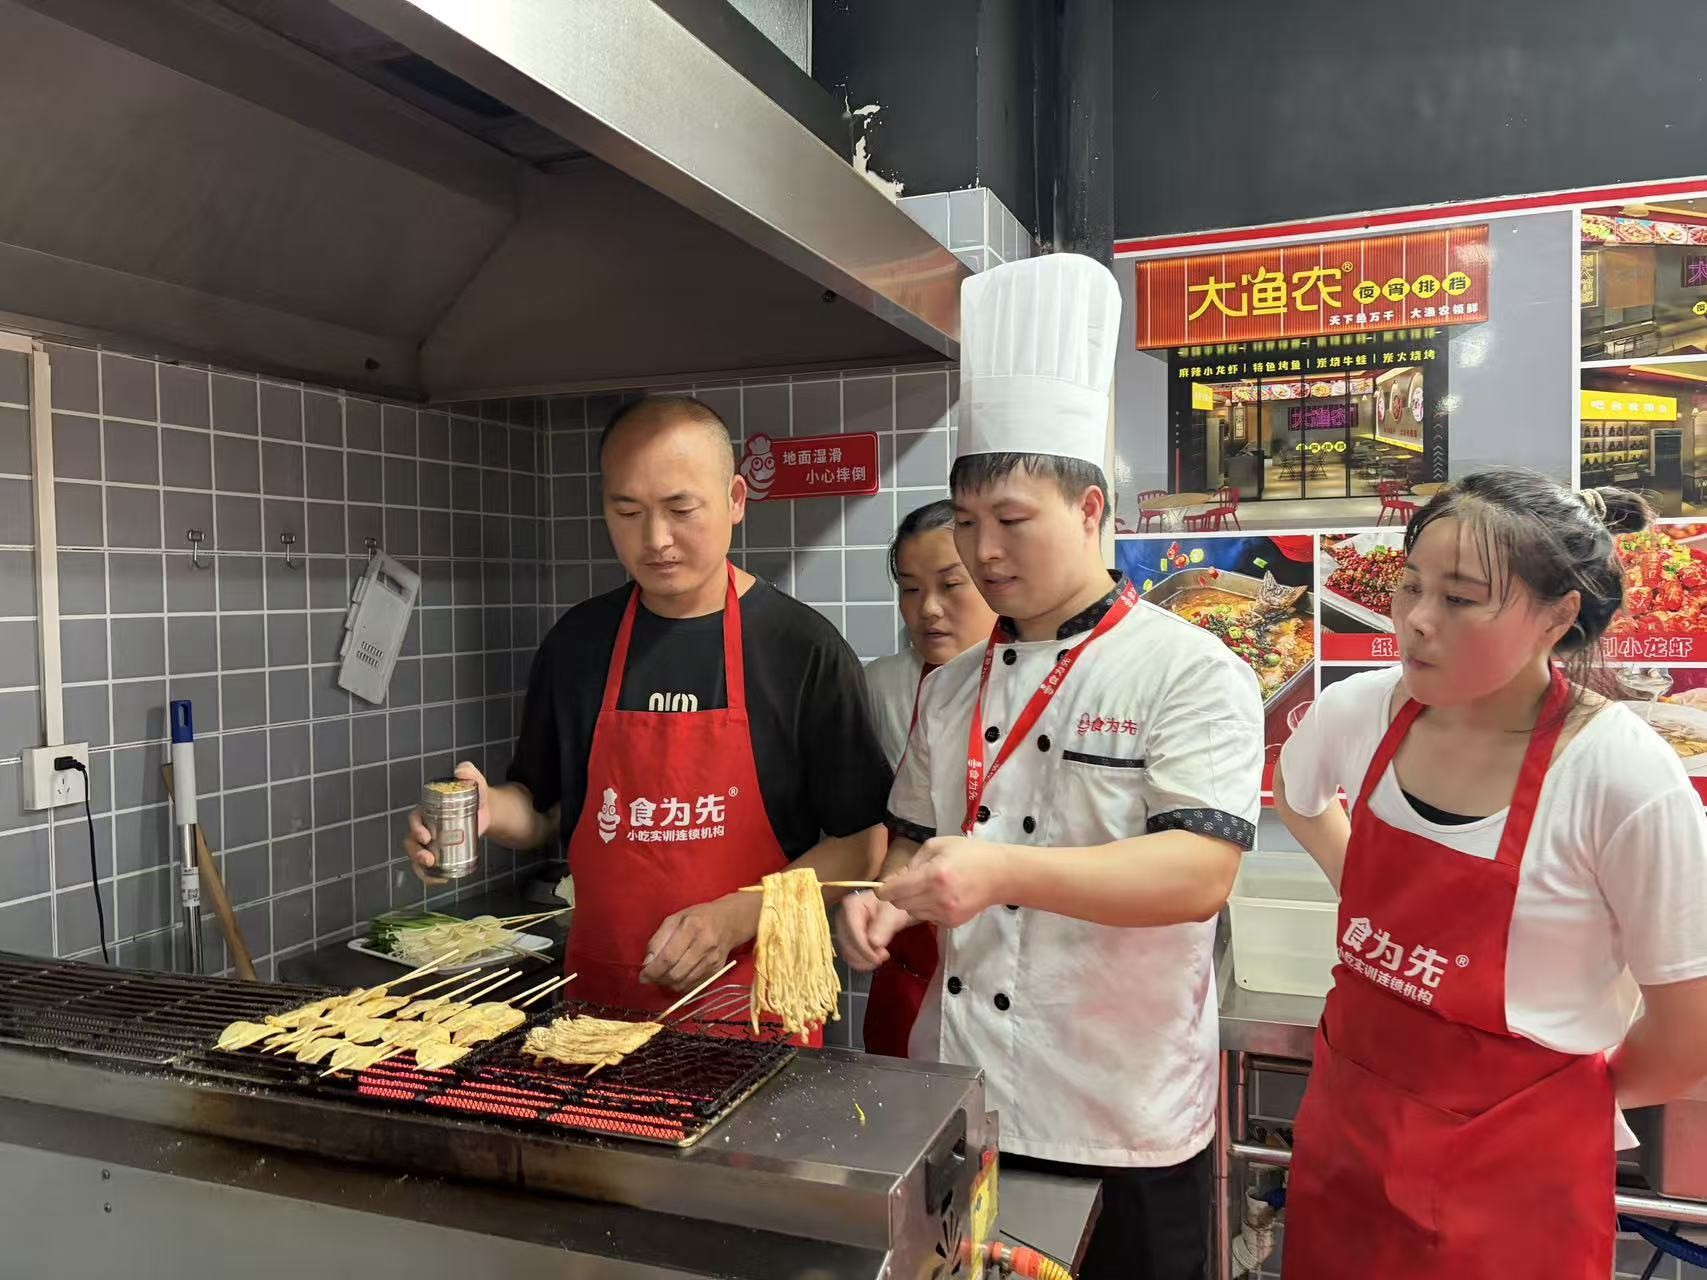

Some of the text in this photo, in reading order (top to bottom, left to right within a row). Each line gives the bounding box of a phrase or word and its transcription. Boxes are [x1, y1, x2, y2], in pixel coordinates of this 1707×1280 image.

[1188, 265, 1342, 321] 大渔农
[1358, 275, 1467, 299] 夜宵排档
[1329, 303, 1479, 326] 天下鱼万千 大渔农领鲜
[1178, 349, 1436, 378] 麻辣小龙虾 特色烤鱼 炭烧牛蛙 炭火烧烤
[783, 447, 842, 466] 地面湿滑
[805, 466, 866, 485] 小心摔倒
[1371, 637, 1400, 657] 纸
[1090, 716, 1138, 736] 食为先
[629, 793, 726, 827] 食为先
[626, 825, 725, 842] 小吃实训连锁机构
[1342, 917, 1449, 989] 食为先
